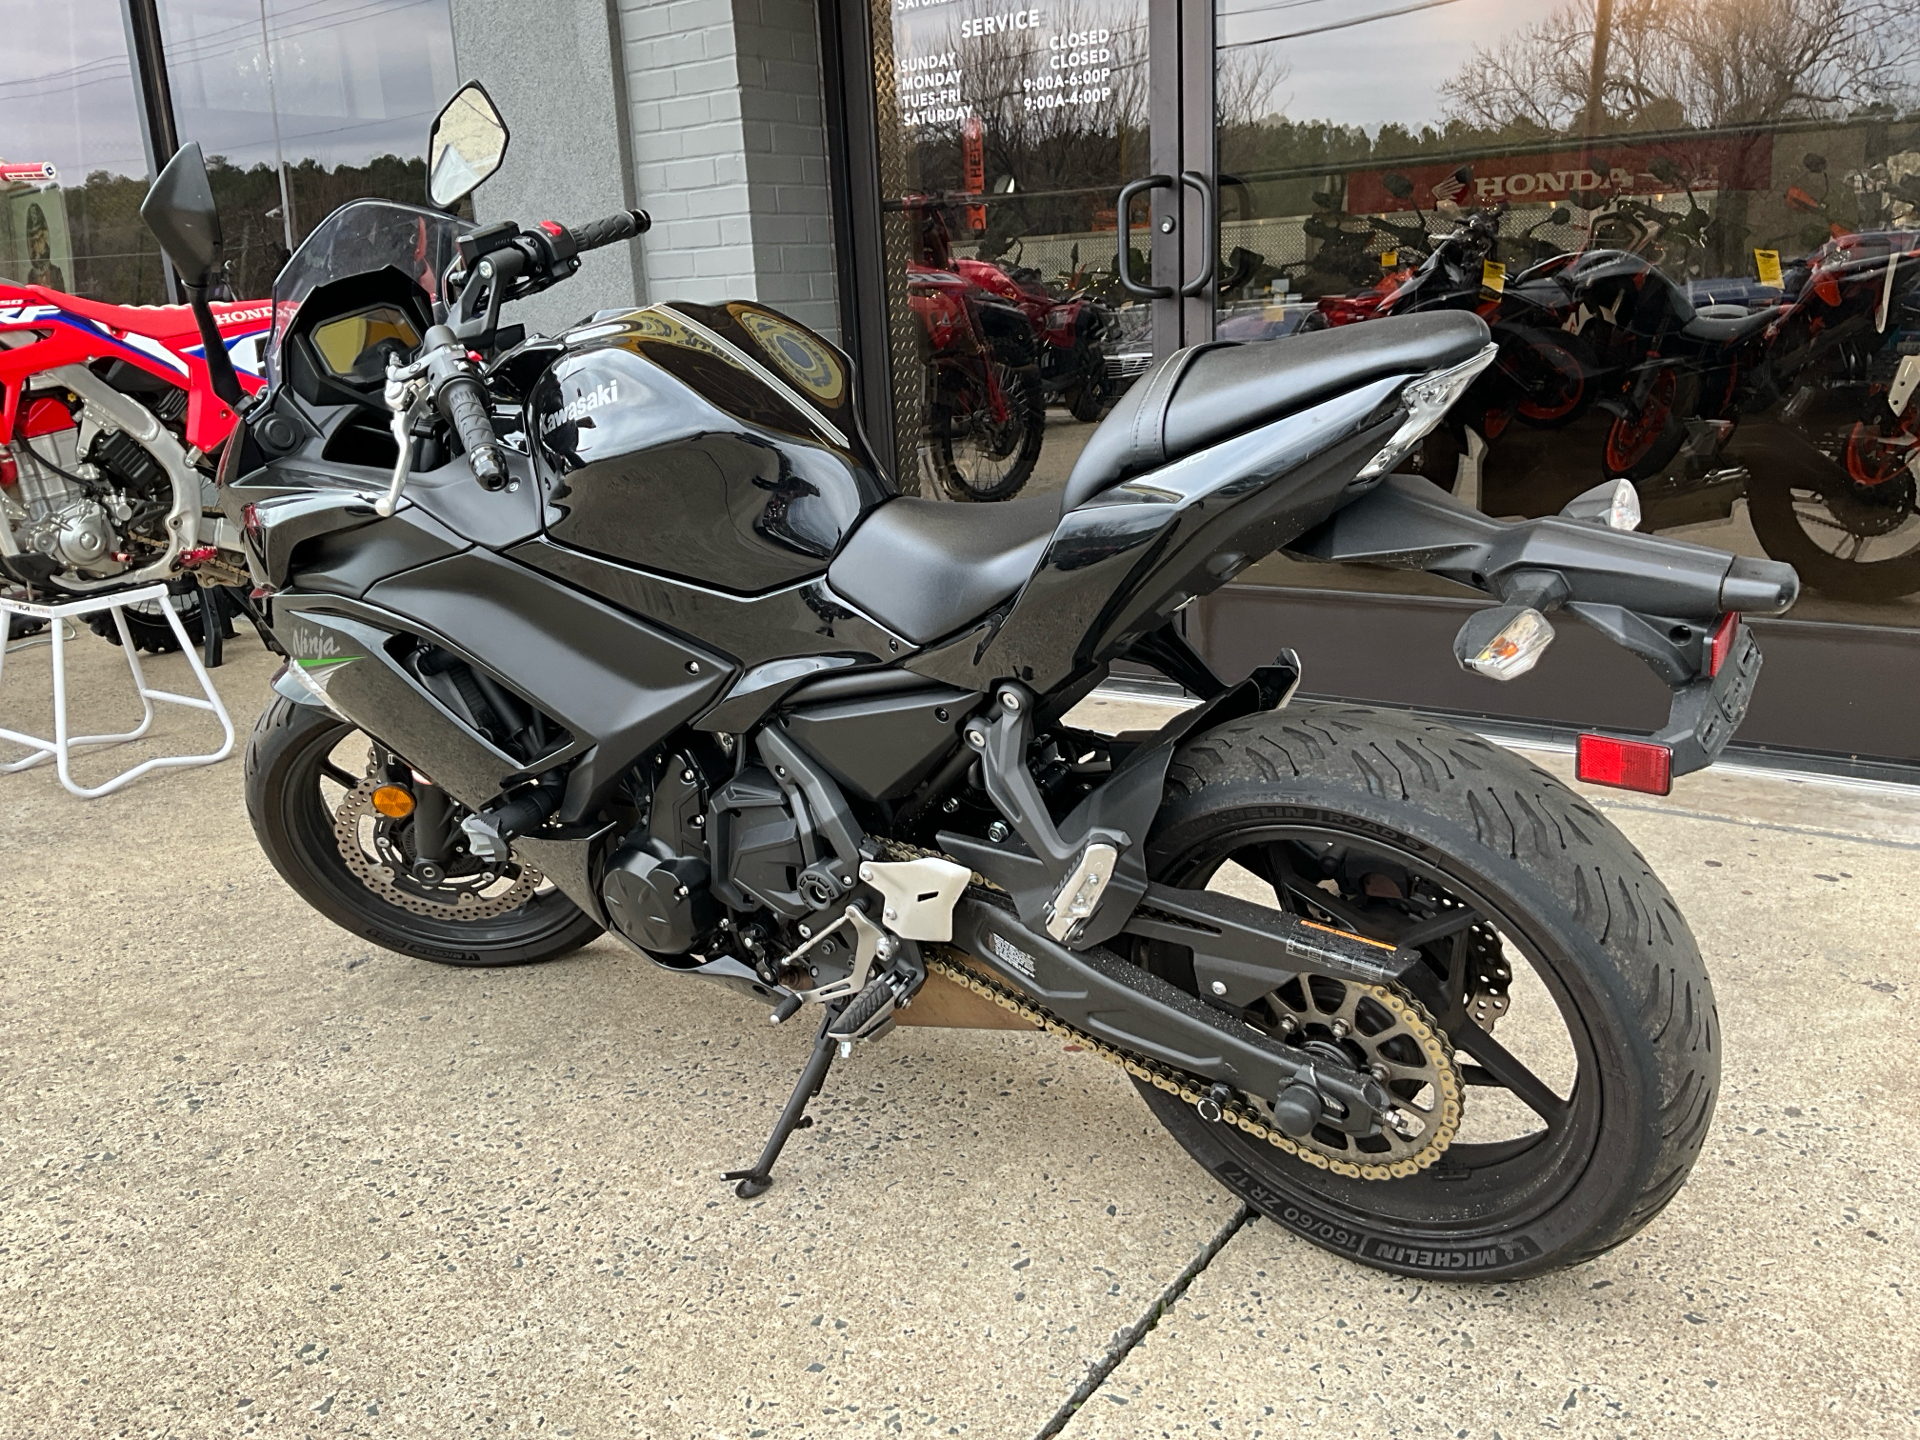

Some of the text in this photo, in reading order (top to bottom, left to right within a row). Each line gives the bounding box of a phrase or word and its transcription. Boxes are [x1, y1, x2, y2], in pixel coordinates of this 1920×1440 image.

[961, 9, 1040, 38] SERVICE
[900, 29, 1110, 73] SUNDAY CLOSED
[902, 48, 1110, 91] MONDAY CLOSED
[902, 68, 1111, 109] TUES-FRI 9:00A-6:00P
[904, 87, 1111, 127] SATURDAY 9:00A-4:00P
[1474, 167, 1634, 198] HONDA
[540, 379, 618, 439] Kawasaki
[292, 627, 341, 661] Ninja
[1329, 813, 1398, 839] ROAD
[1224, 1169, 1498, 1268] MICHELIN 160/60 ZR 17
